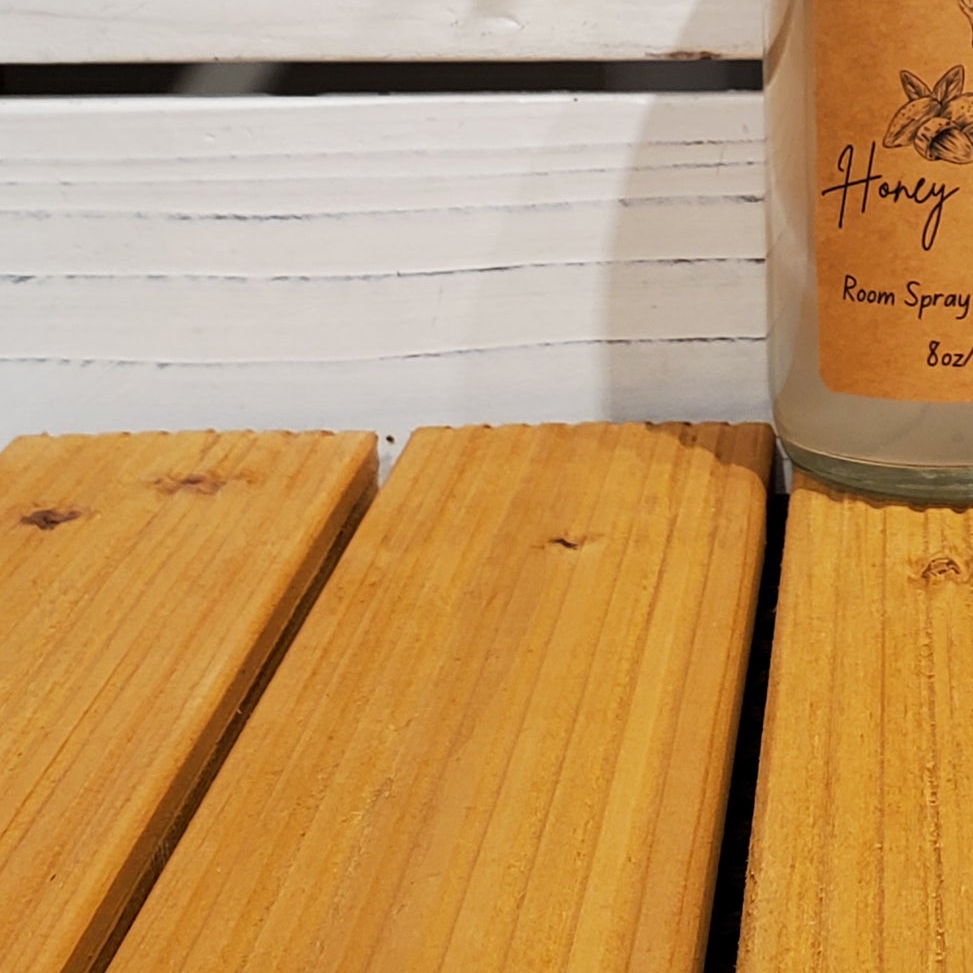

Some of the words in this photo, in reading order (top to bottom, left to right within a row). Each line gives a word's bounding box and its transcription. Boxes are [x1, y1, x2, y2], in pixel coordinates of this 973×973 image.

[821, 142, 960, 251] Honey
[843, 275, 895, 307] Room
[904, 281, 971, 320] Spray
